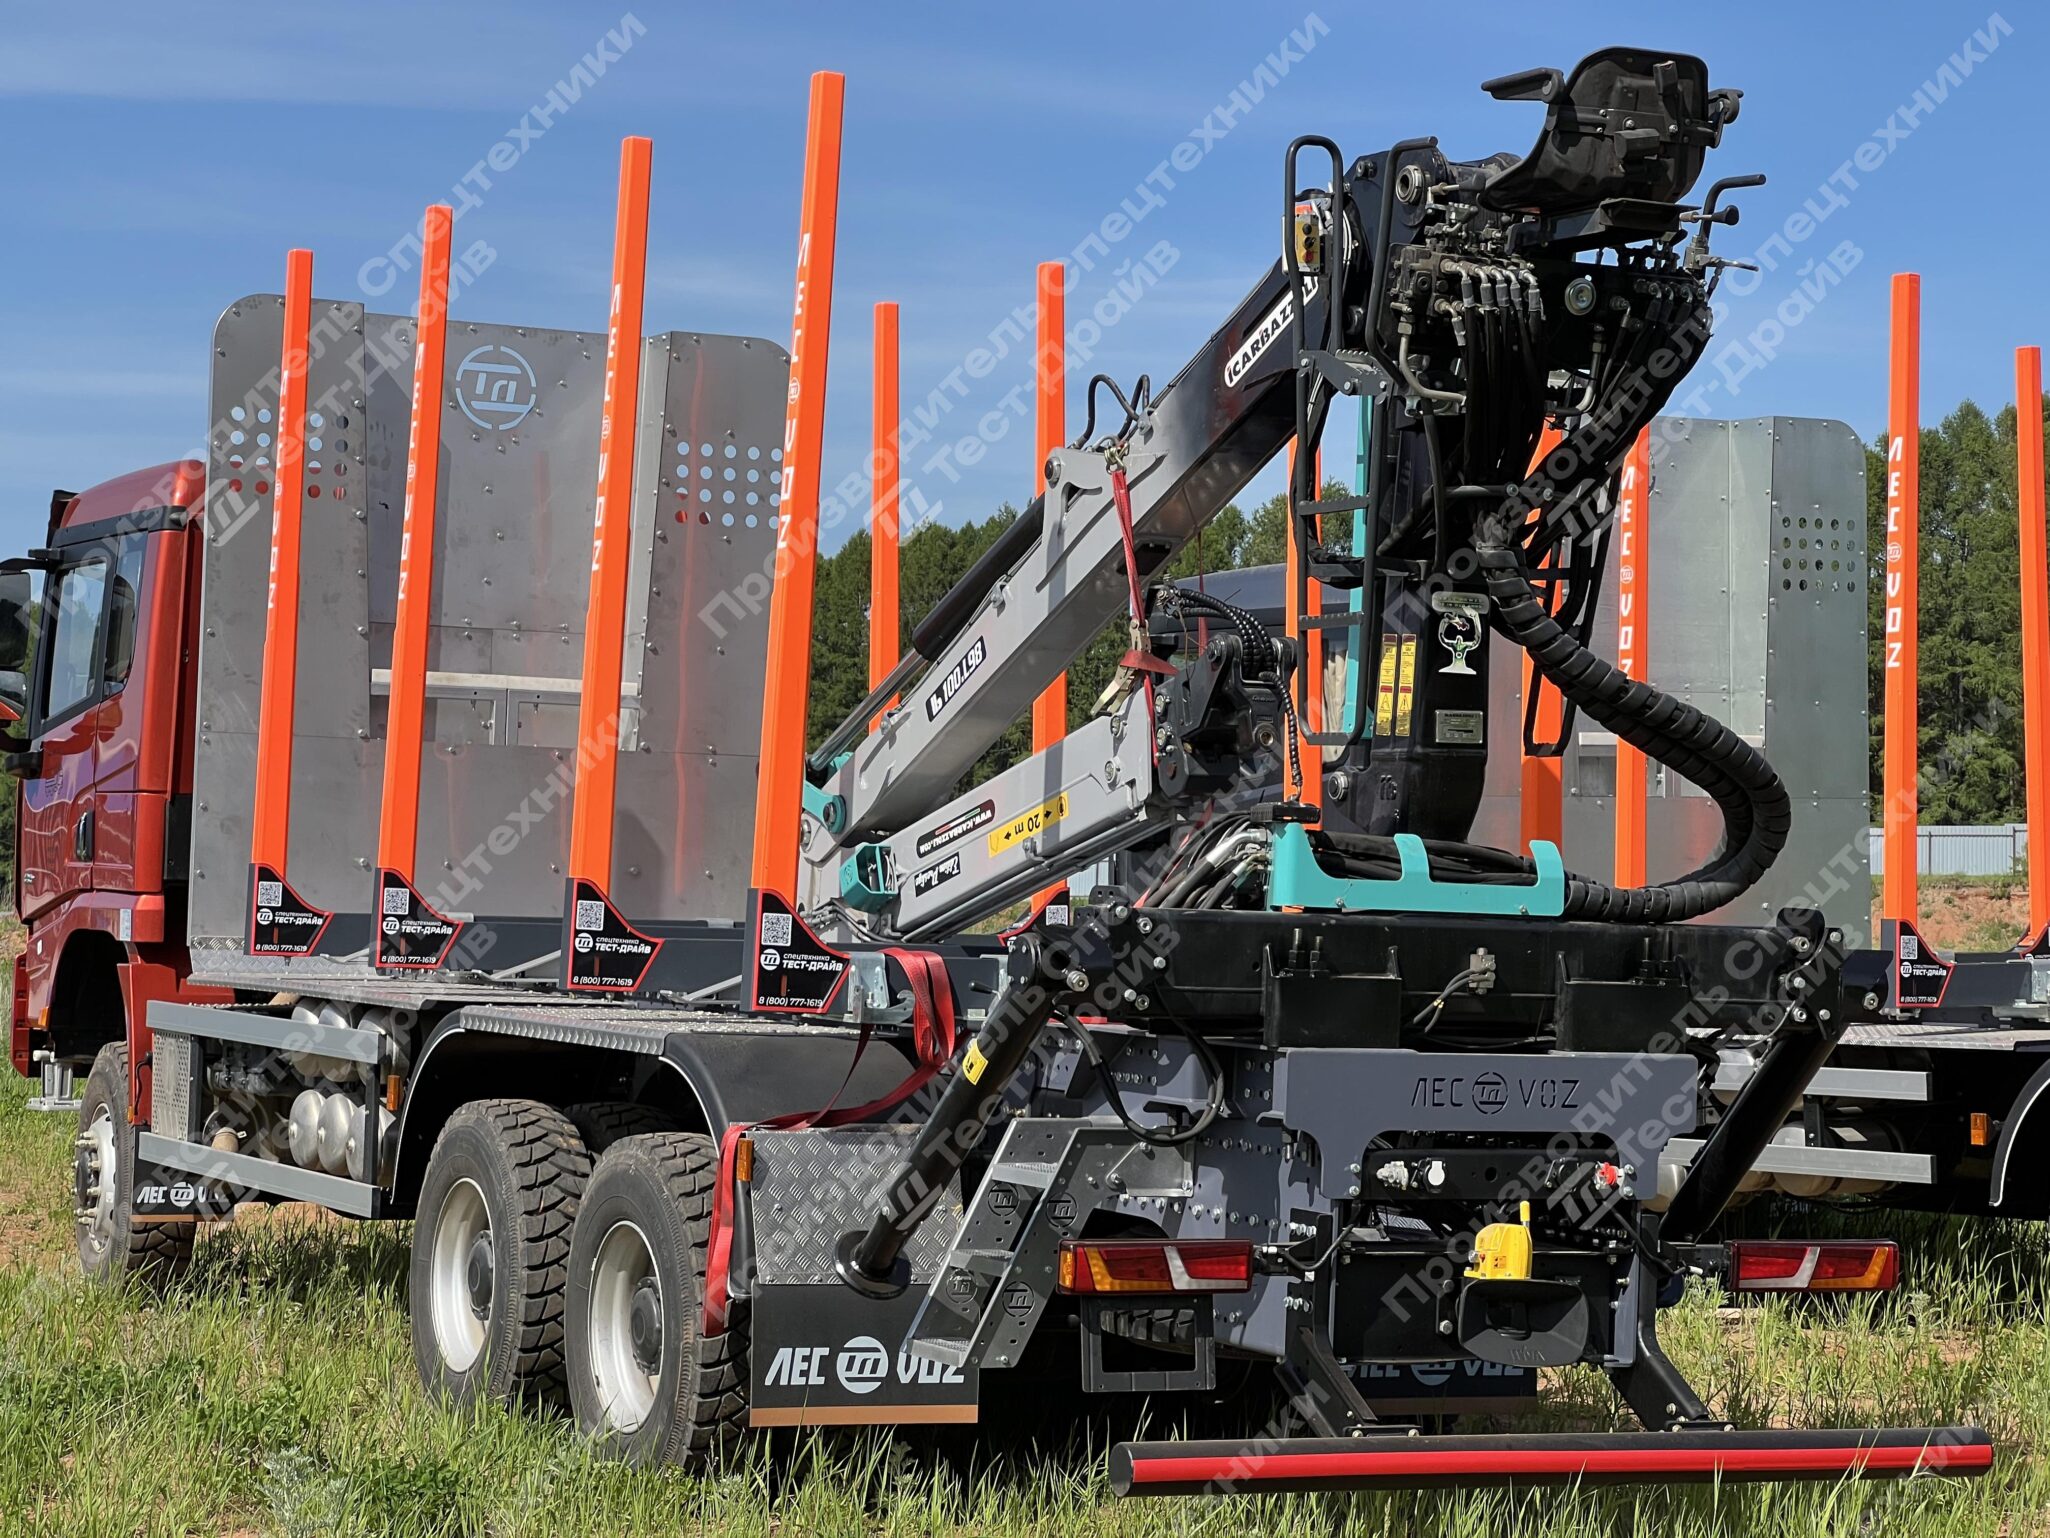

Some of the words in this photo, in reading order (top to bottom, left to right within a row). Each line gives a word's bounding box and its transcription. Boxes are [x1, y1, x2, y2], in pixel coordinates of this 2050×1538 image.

[942, 640, 983, 703] 100.L98
[1014, 822, 1024, 835] m
[1028, 813, 1041, 833] 20
[274, 916, 323, 925] ТЕСТ-ДРАЙВ
[401, 925, 453, 935] ТЕСТ-ДРАЙВ
[595, 943, 652, 954] ТЕСТ-ДРАЙВ
[782, 960, 843, 972] ТЕСТ-ДРАЙВ
[580, 976, 601, 985] (800)
[601, 977, 633, 986] 777-1619
[758, 996, 765, 1004] 8
[766, 996, 788, 1006] (800)
[789, 997, 824, 1007] 777-1619
